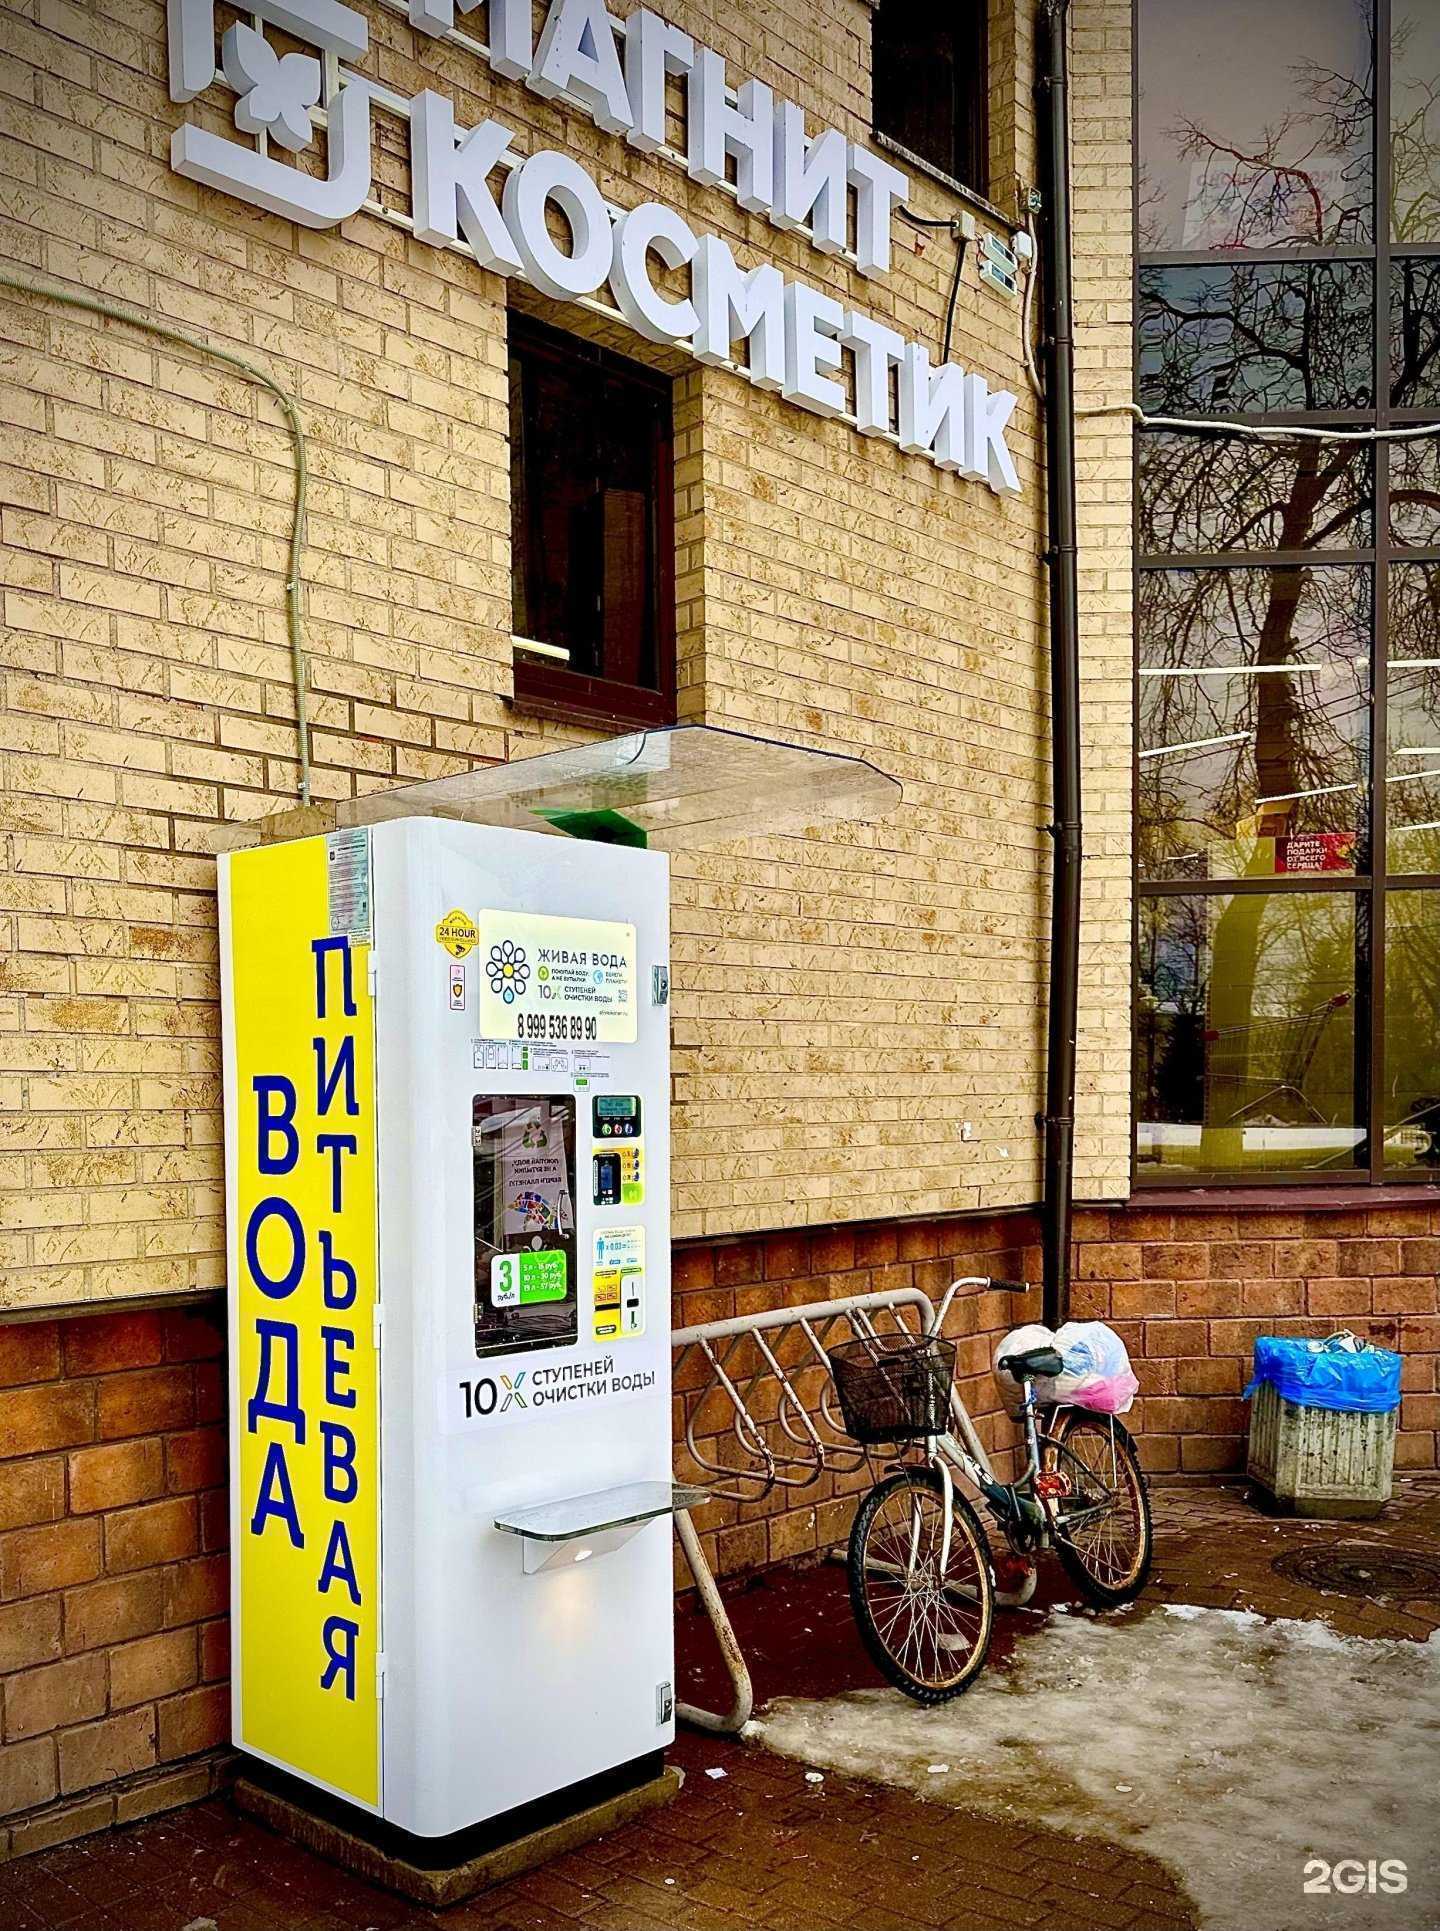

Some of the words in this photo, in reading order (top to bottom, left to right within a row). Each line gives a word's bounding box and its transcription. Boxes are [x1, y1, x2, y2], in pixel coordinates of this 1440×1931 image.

[410, 88, 1022, 498] КОСМЕТИК
[1287, 841, 1320, 849] ДАРИТЕ
[439, 927, 450, 936] 24
[451, 928, 476, 938] HOUR
[538, 949, 587, 965] ЖИВАЯ
[592, 953, 627, 969] ВОДА
[564, 985, 596, 994] СТУПЕНЕЙ
[517, 1013, 524, 1038] 8
[527, 1013, 547, 1039] 999
[549, 1014, 567, 1039] 536
[570, 1015, 582, 1040] 89
[585, 1016, 597, 1040] 90
[499, 1260, 513, 1292] 3
[246, 1076, 306, 1549] ВОДА
[311, 935, 362, 1701] ПИТЬЕВАЯ
[532, 1355, 614, 1386] СТУПЕНЕЙ
[532, 1380, 607, 1406] ОЧИСТКИ
[611, 1371, 655, 1392] ВОДЫ
